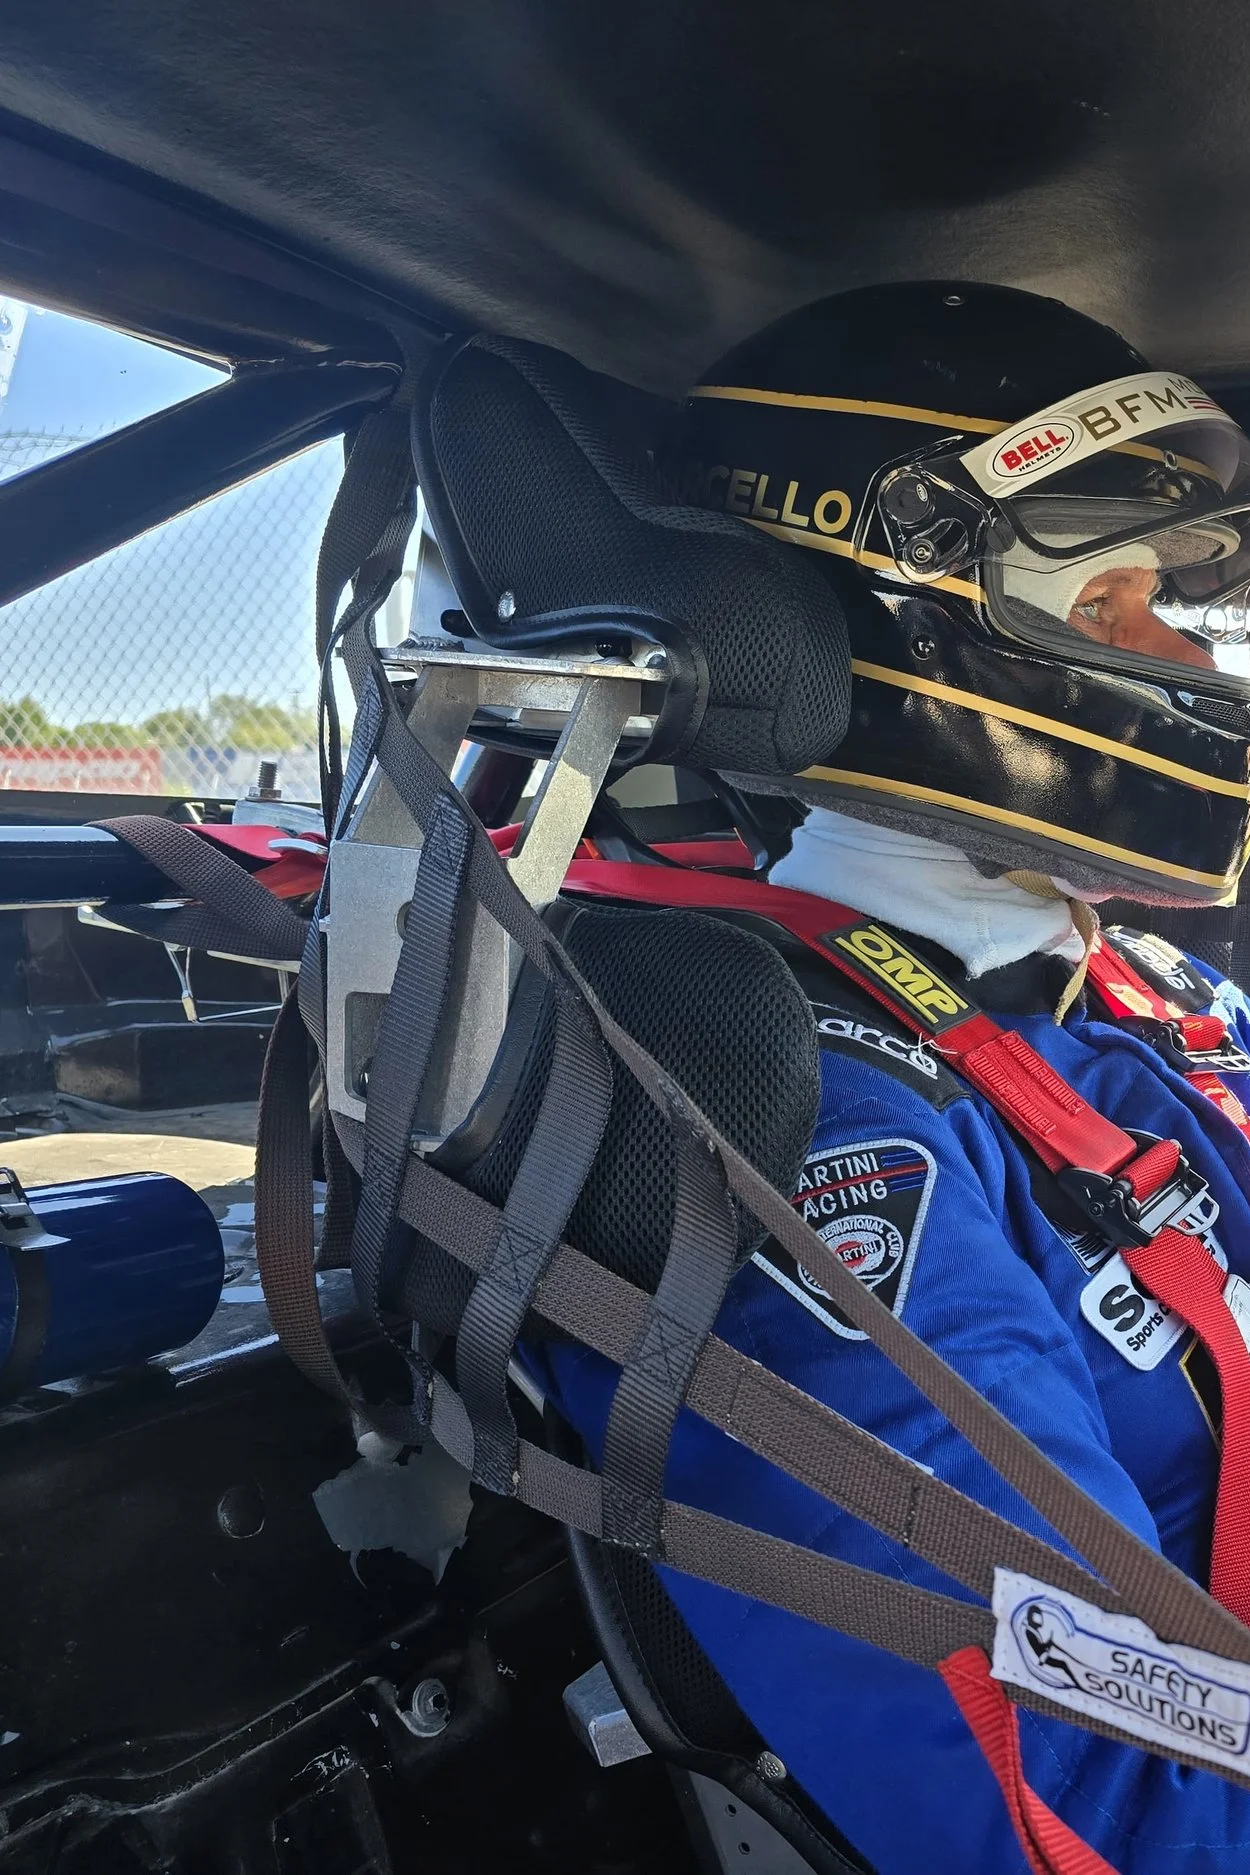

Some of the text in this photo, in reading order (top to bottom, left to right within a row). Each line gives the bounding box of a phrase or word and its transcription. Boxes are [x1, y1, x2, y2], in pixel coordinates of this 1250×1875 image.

[1078, 386, 1188, 442] BFM
[1001, 429, 1066, 471] BELL
[1018, 447, 1062, 472] HELMETS
[850, 930, 958, 1015] OMP
[817, 1017, 938, 1080] arco
[798, 1152, 880, 1193] ARTINI
[803, 1179, 888, 1222] ACING
[821, 1217, 884, 1240] TERNATIONAL
[1126, 1312, 1165, 1352] Sports
[1111, 1651, 1212, 1708] SAFETY
[1084, 1672, 1237, 1747] SOLUTIONS
